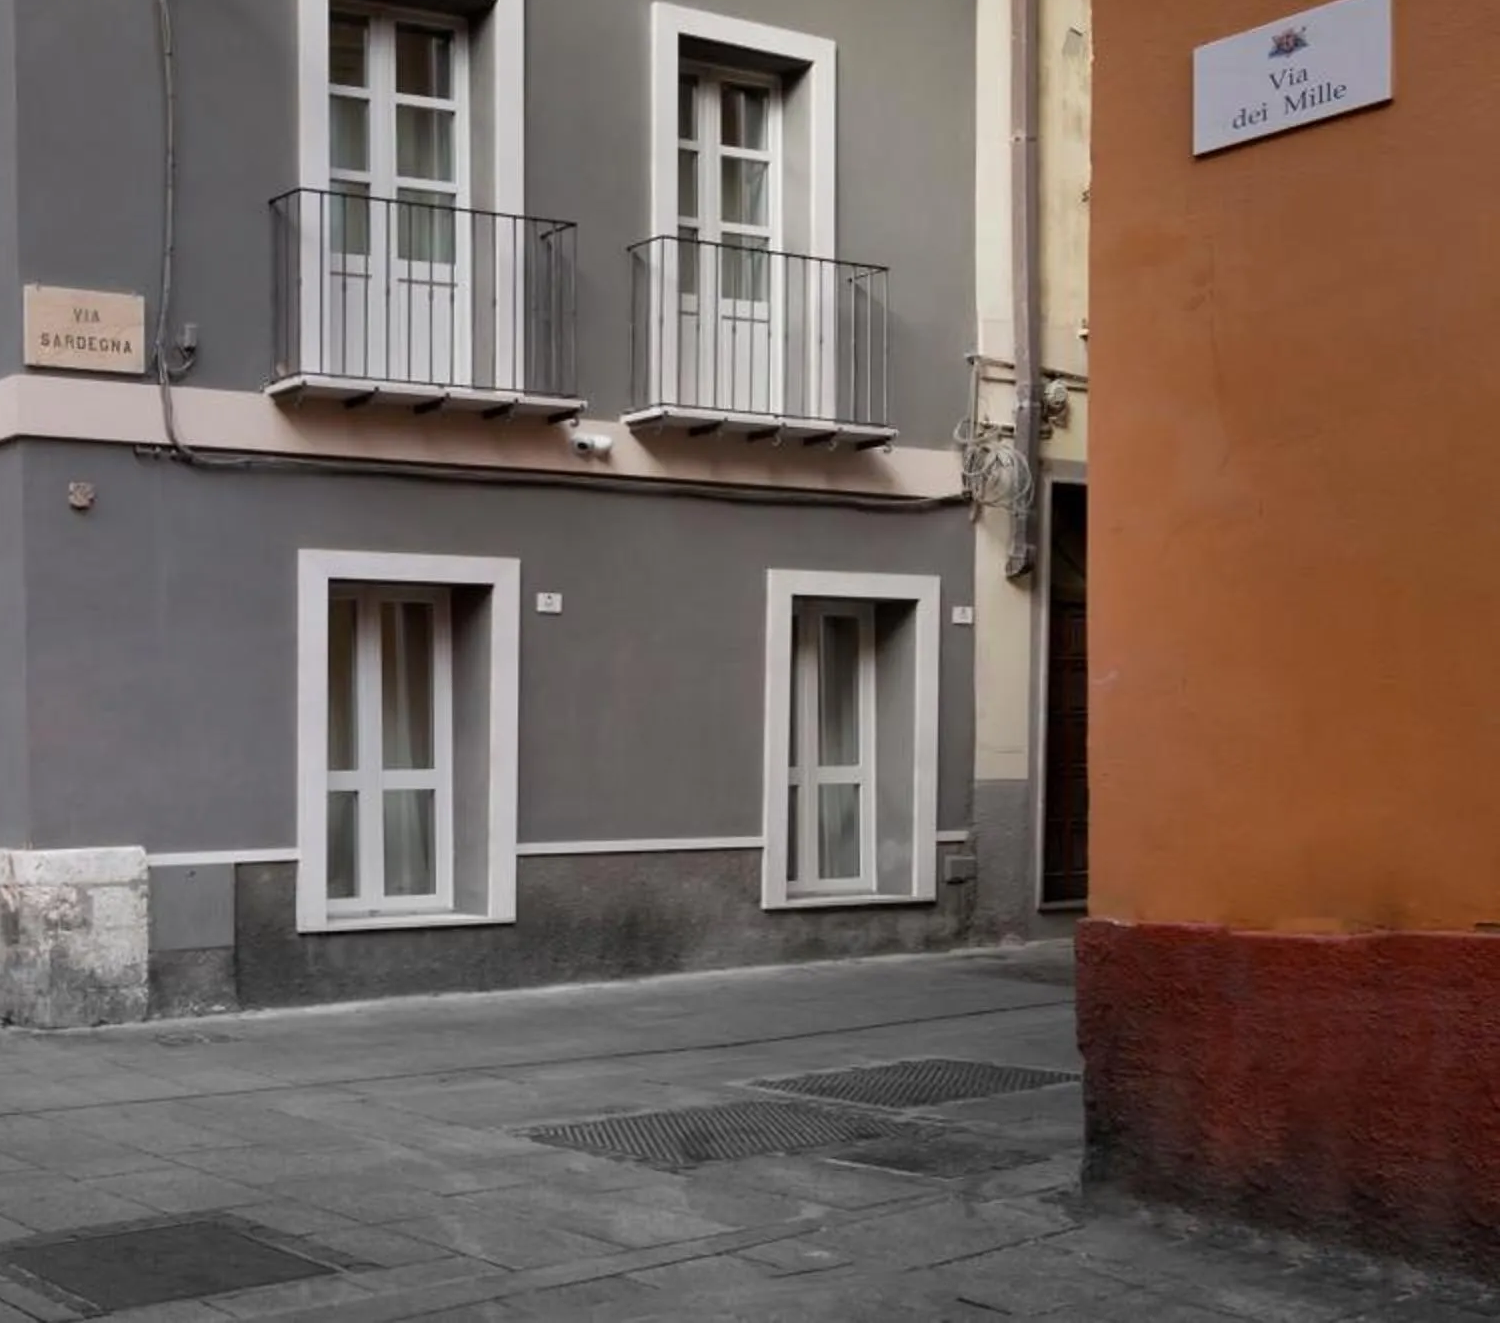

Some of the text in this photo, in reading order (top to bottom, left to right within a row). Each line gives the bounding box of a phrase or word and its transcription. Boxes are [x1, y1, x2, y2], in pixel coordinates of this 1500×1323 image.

[1269, 67, 1309, 91] Via
[1232, 81, 1348, 130] dei Mille
[73, 307, 100, 323] VIA
[41, 332, 132, 355] SARDEGNA
